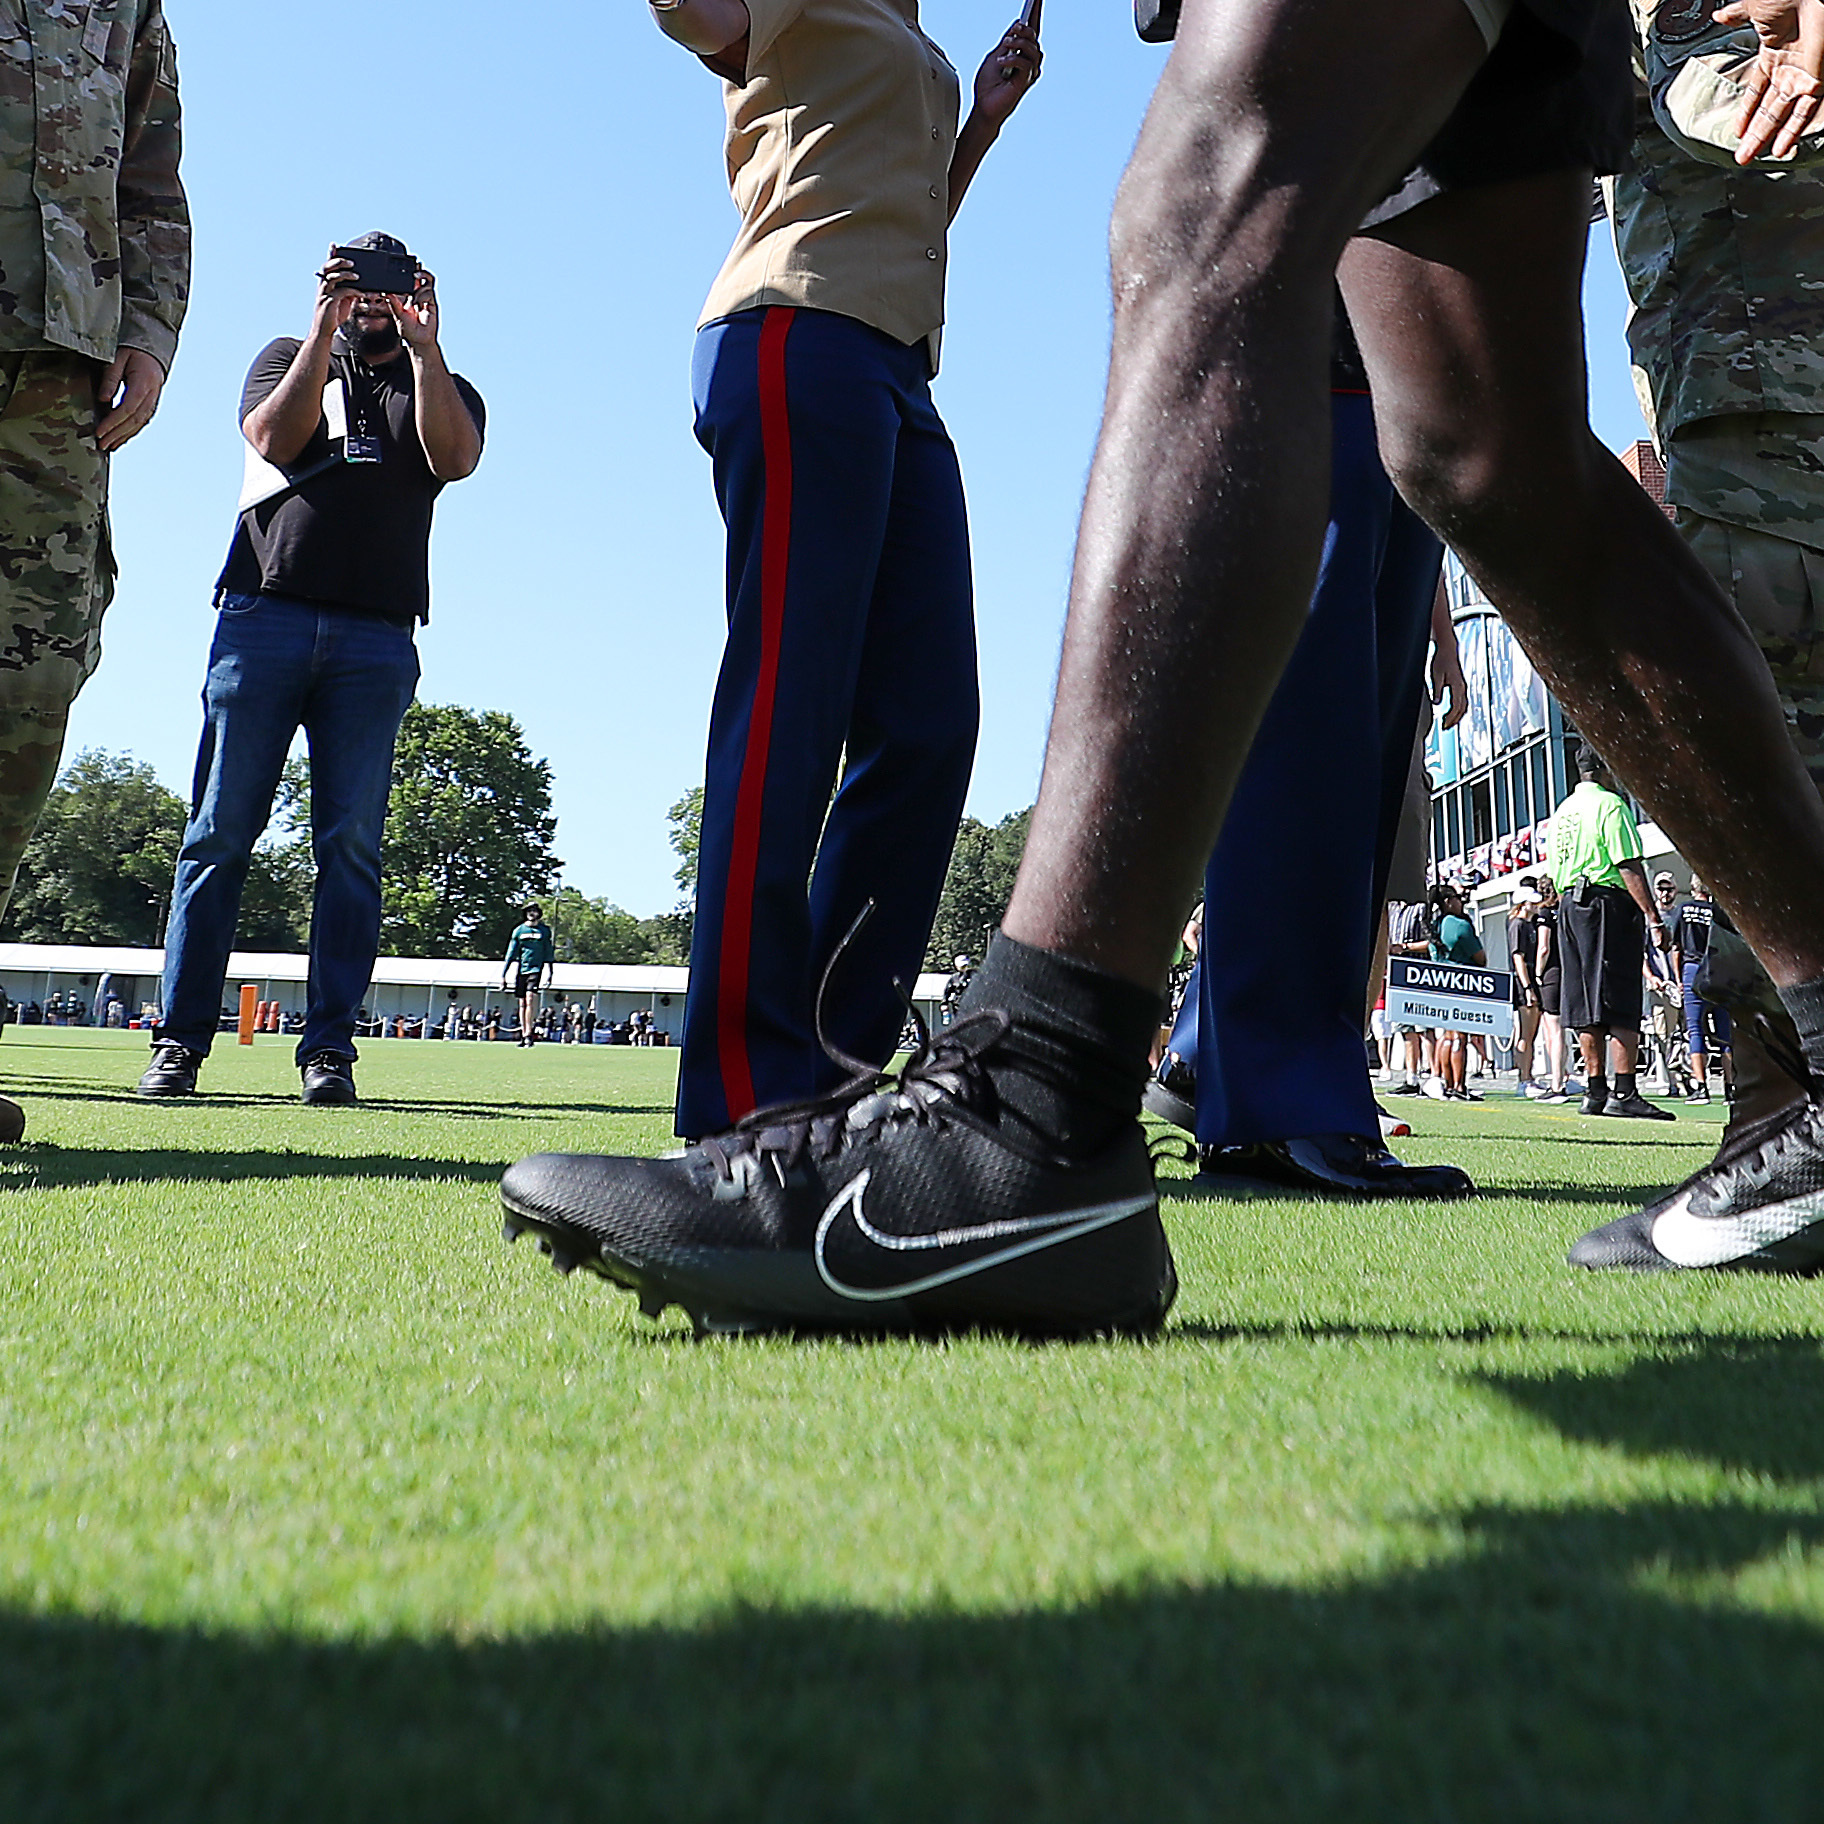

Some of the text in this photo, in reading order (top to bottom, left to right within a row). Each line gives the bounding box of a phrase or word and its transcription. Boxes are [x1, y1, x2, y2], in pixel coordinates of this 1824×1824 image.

[1407, 967, 1494, 993] DAWKINS
[1404, 1002, 1494, 1024] Military Guests
